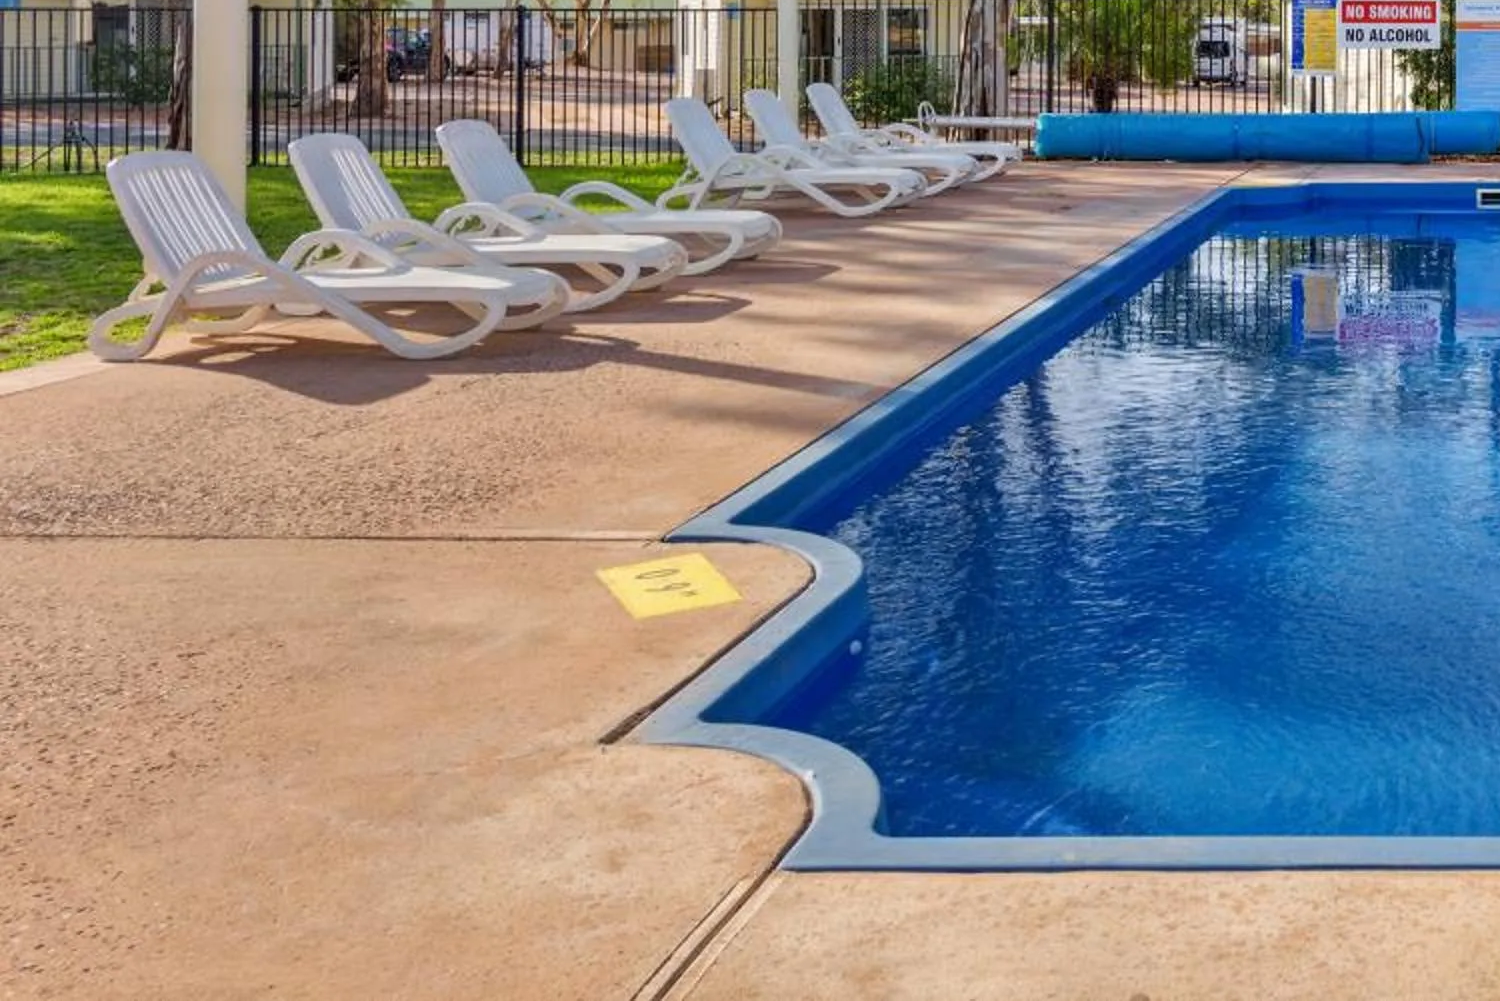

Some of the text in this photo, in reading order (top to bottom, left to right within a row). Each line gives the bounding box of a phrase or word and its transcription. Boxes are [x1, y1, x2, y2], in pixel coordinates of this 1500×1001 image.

[1345, 5, 1431, 20] NO SMOKING
[1345, 28, 1432, 42] NO ALCOHOL
